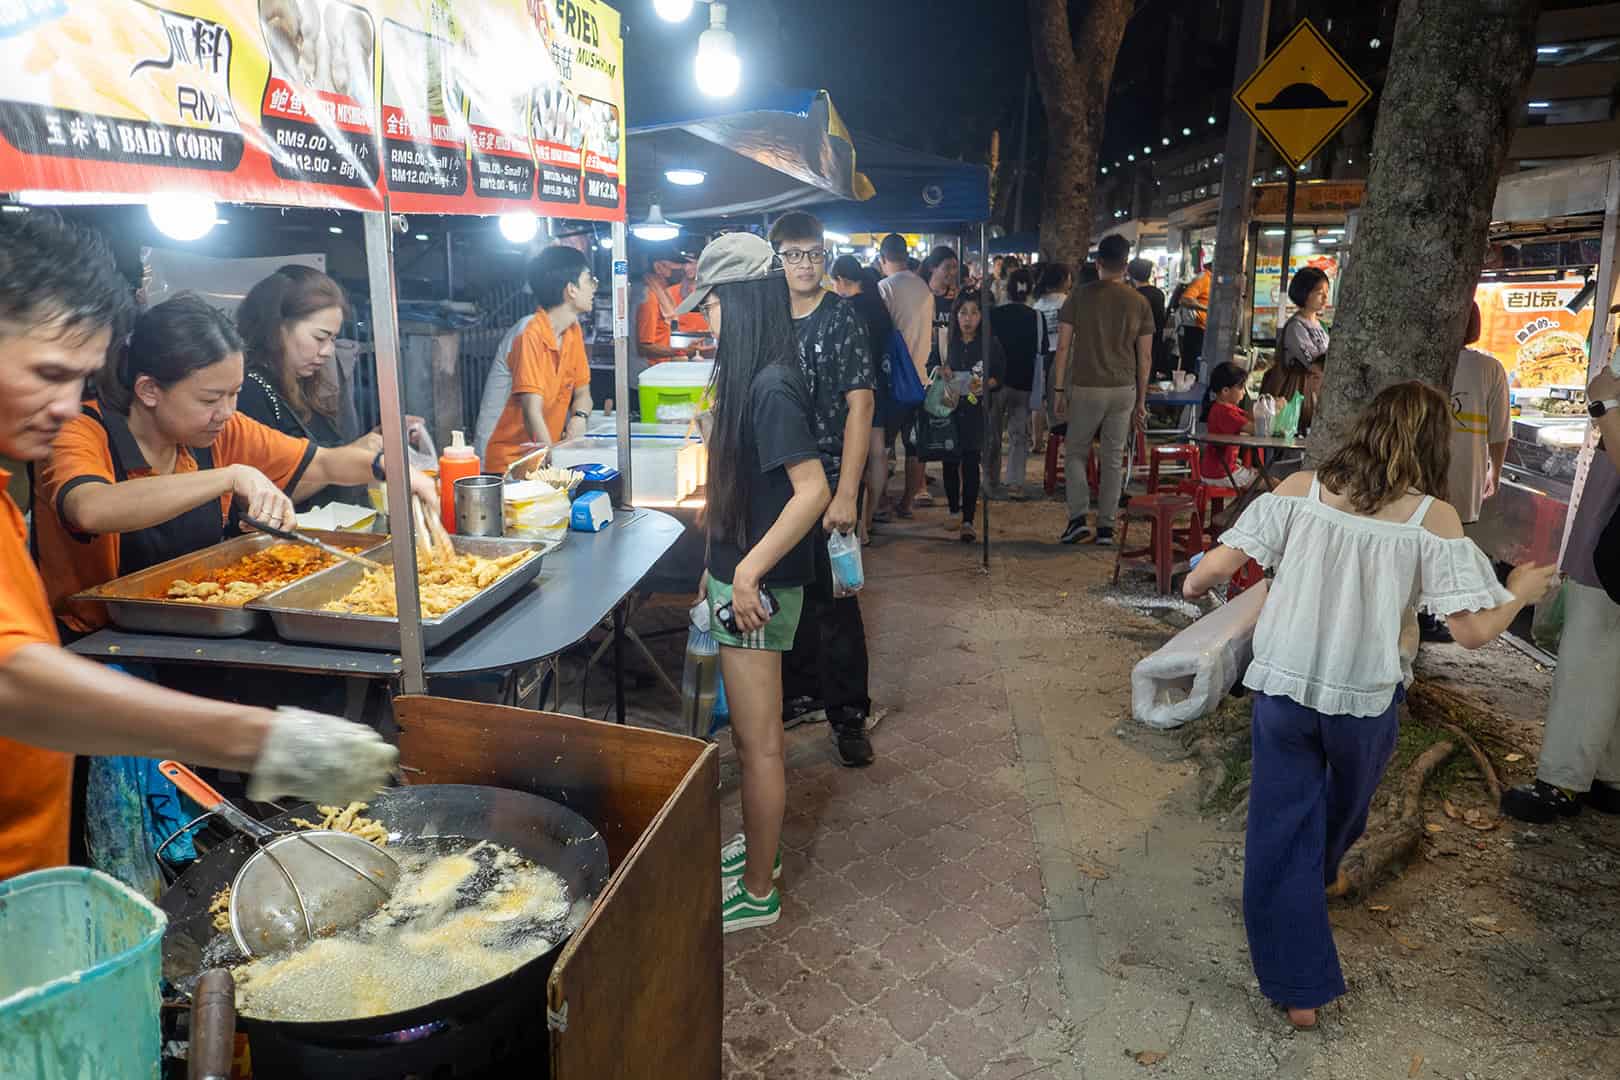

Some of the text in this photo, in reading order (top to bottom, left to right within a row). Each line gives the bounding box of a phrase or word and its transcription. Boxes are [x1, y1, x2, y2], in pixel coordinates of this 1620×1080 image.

[117, 125, 223, 161] BABY CORN
[276, 129, 328, 151] RM9.00
[391, 167, 430, 184] RM12.00
